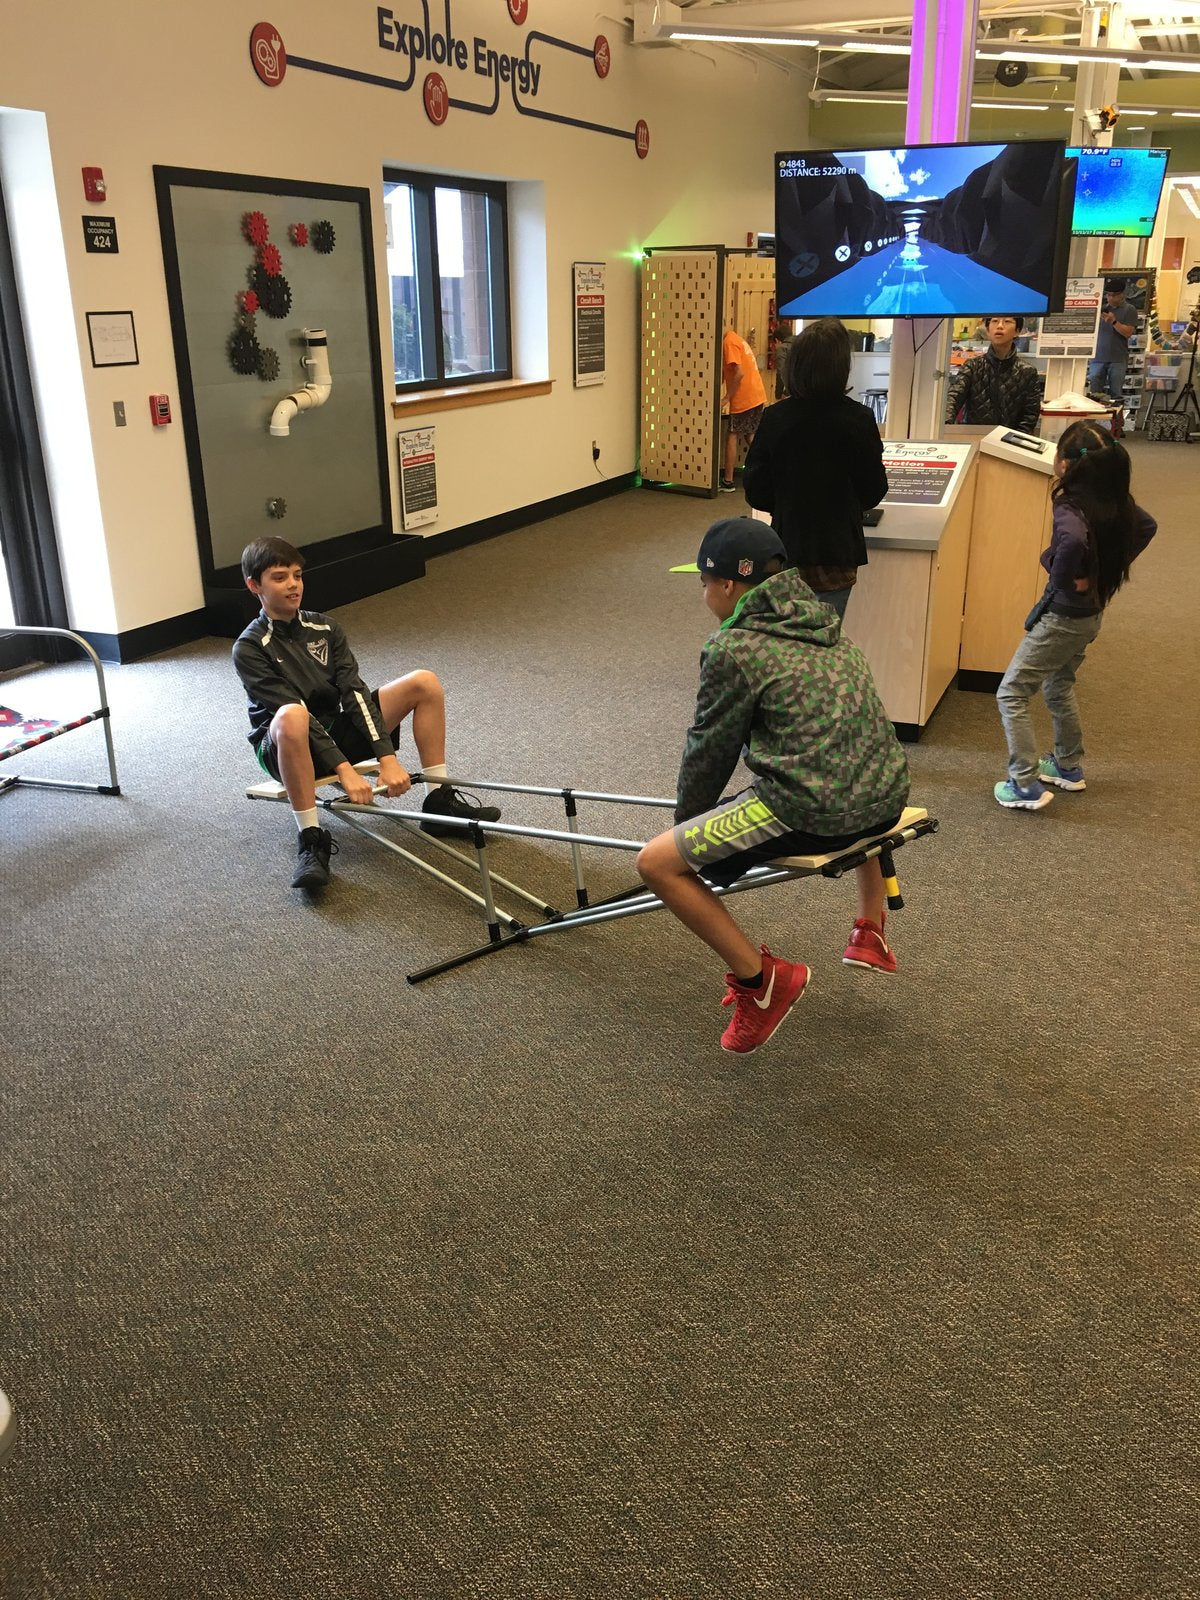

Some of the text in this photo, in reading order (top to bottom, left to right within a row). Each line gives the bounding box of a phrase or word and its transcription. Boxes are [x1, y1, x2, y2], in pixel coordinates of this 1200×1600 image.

[377, 6, 541, 96] Explore Energy
[786, 160, 806, 168] 4843
[780, 168, 821, 178] DISTANCE:
[822, 166, 847, 176] 52290
[93, 235, 111, 248] 424
